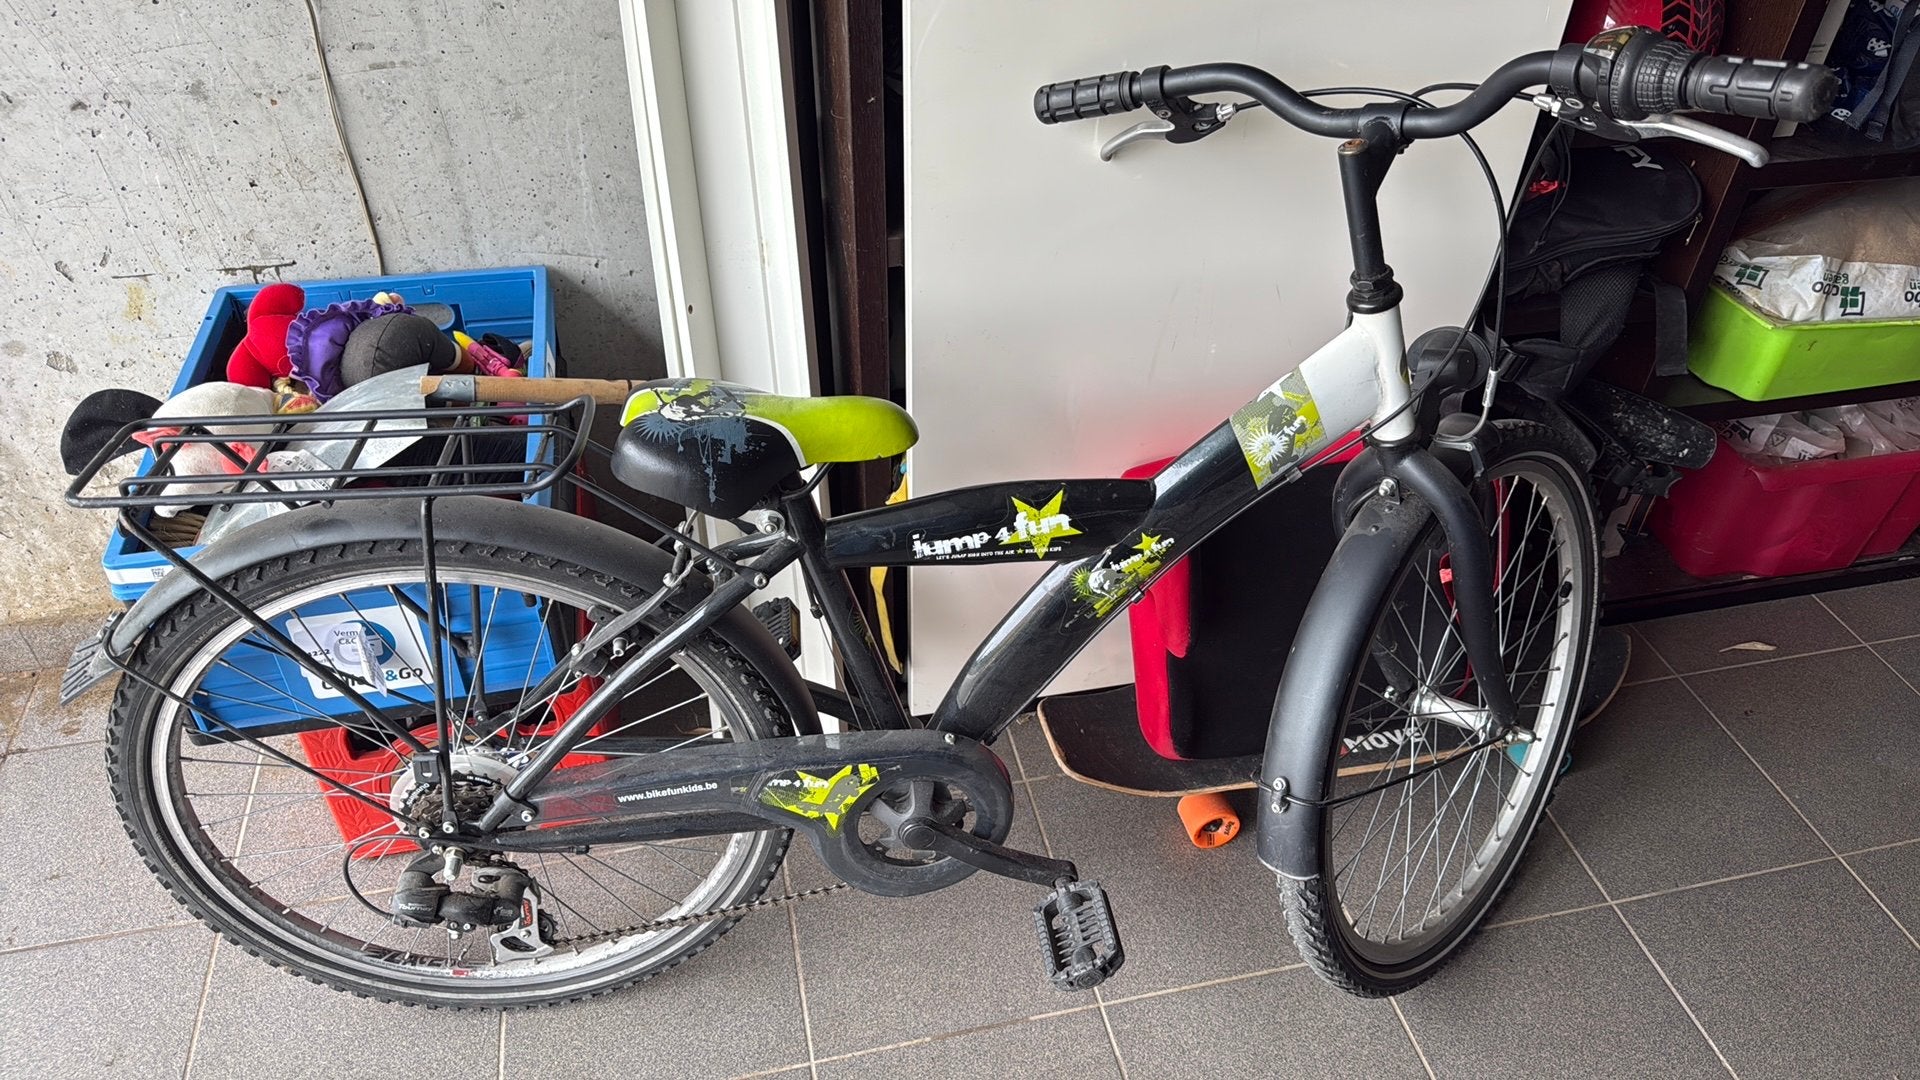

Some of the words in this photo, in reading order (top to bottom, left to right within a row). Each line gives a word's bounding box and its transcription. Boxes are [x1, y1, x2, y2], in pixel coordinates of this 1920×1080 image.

[912, 534, 992, 559] jump
[995, 526, 1014, 544] 4
[1014, 511, 1073, 540] fun
[617, 781, 718, 803] www.bikefunkids.be
